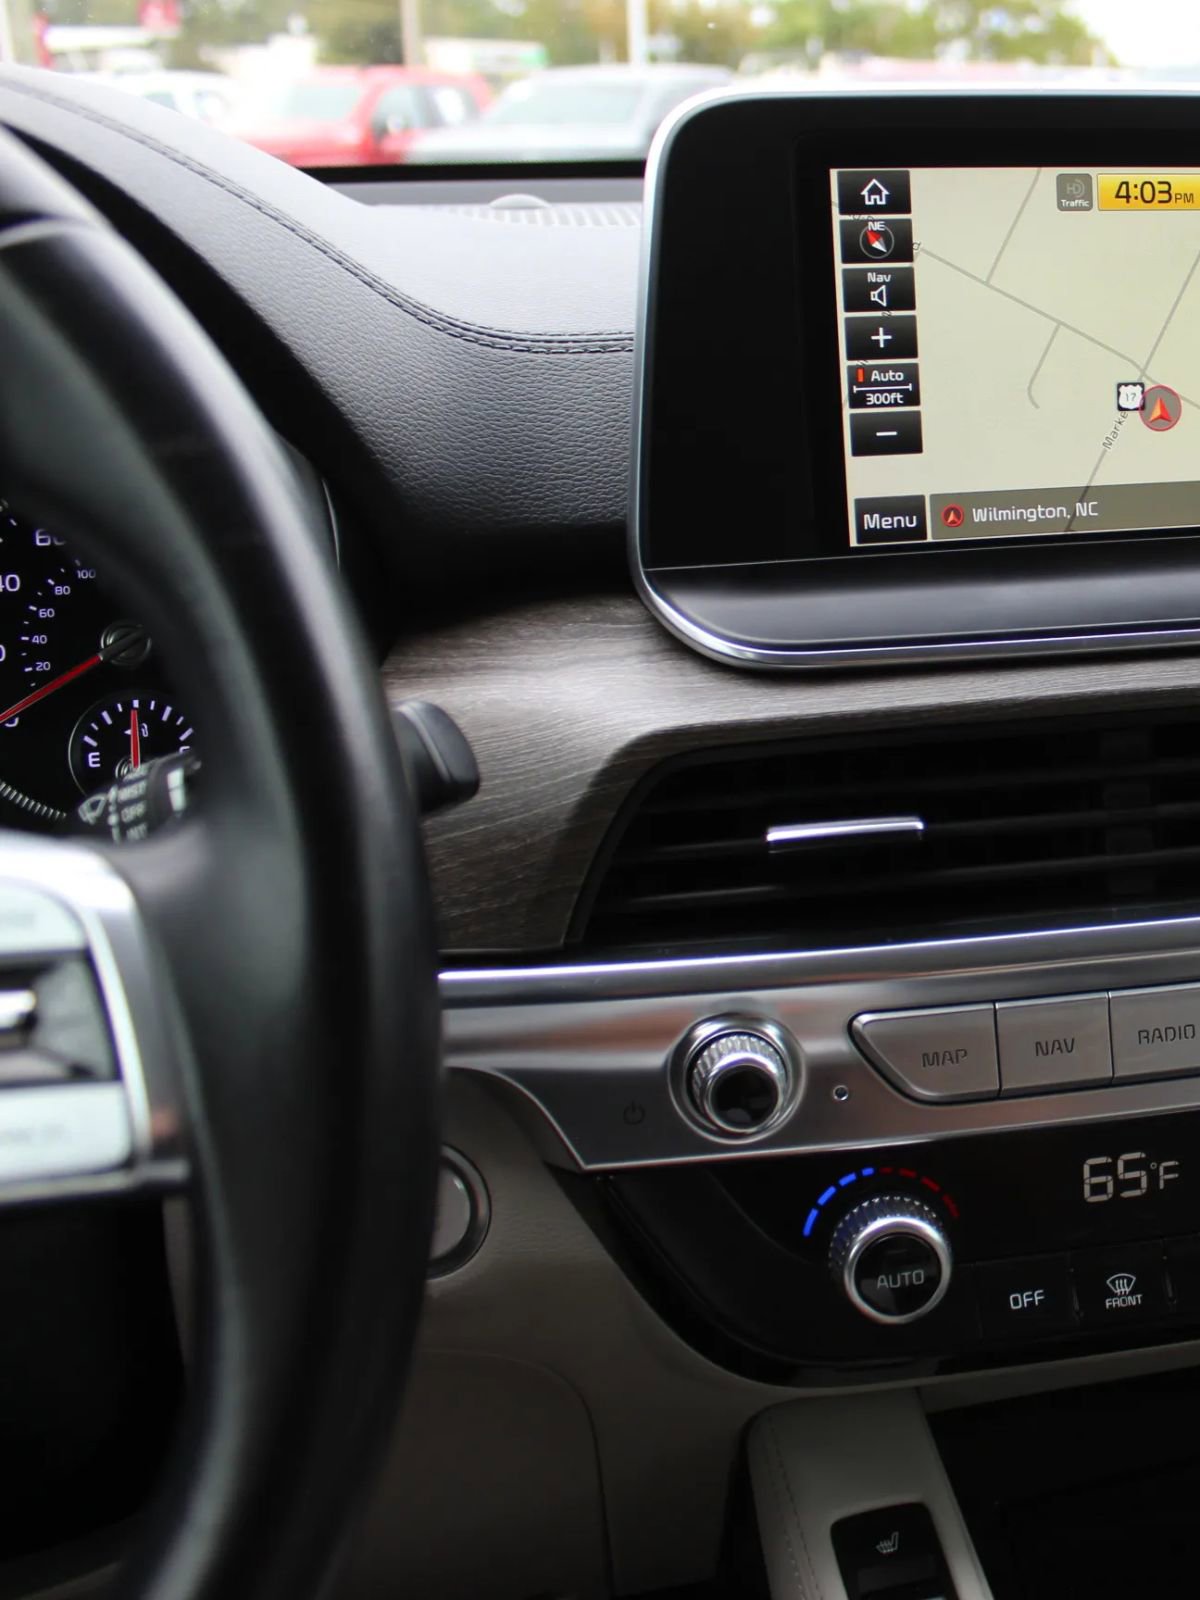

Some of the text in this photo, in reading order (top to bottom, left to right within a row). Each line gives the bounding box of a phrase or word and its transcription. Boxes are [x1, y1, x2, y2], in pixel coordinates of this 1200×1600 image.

[1114, 180, 1195, 204] 4:03 PM
[1061, 199, 1089, 208] Traffic
[868, 221, 886, 231] NE
[867, 272, 892, 282] Nav
[871, 369, 905, 382] Auto
[865, 392, 904, 405] 300ft
[972, 501, 1099, 524] Wilmington, NC
[863, 513, 918, 531] Menu
[77, 569, 96, 579] 100
[54, 586, 71, 596] 80
[39, 608, 55, 618] 60
[31, 635, 48, 644] 40
[35, 661, 51, 672] 20
[88, 752, 101, 768] E
[1138, 1023, 1196, 1045] RADIO
[1034, 1037, 1076, 1057] NAV
[921, 1048, 968, 1068] MAP
[876, 1269, 925, 1290] AUTO
[1009, 1290, 1045, 1310] OFF
[1105, 1294, 1143, 1310] FRONT
